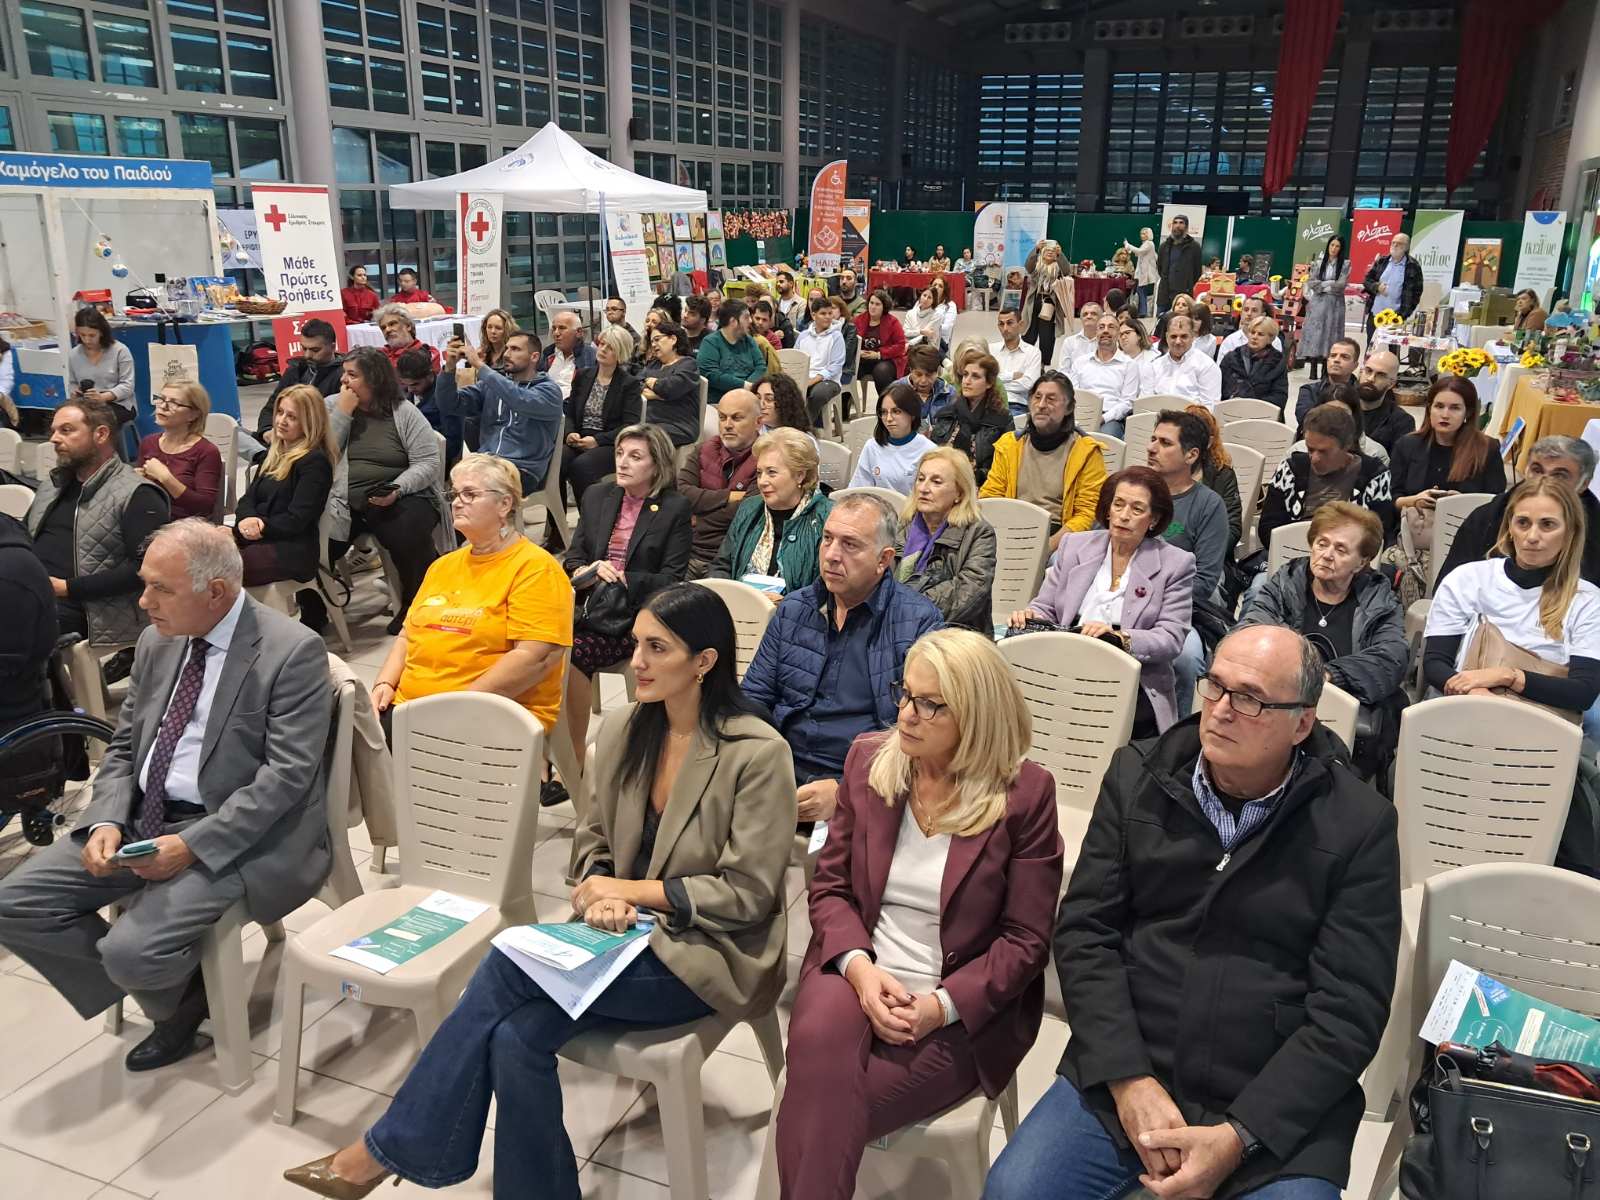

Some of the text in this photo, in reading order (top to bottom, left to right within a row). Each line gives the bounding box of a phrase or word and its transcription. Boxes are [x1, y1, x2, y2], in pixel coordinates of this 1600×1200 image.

[81, 167, 110, 180] του
[114, 164, 173, 181] Παιδιού
[283, 256, 316, 270] Μάθε
[280, 271, 328, 289] Πρώτες
[278, 288, 334, 304] Βοήθειες
